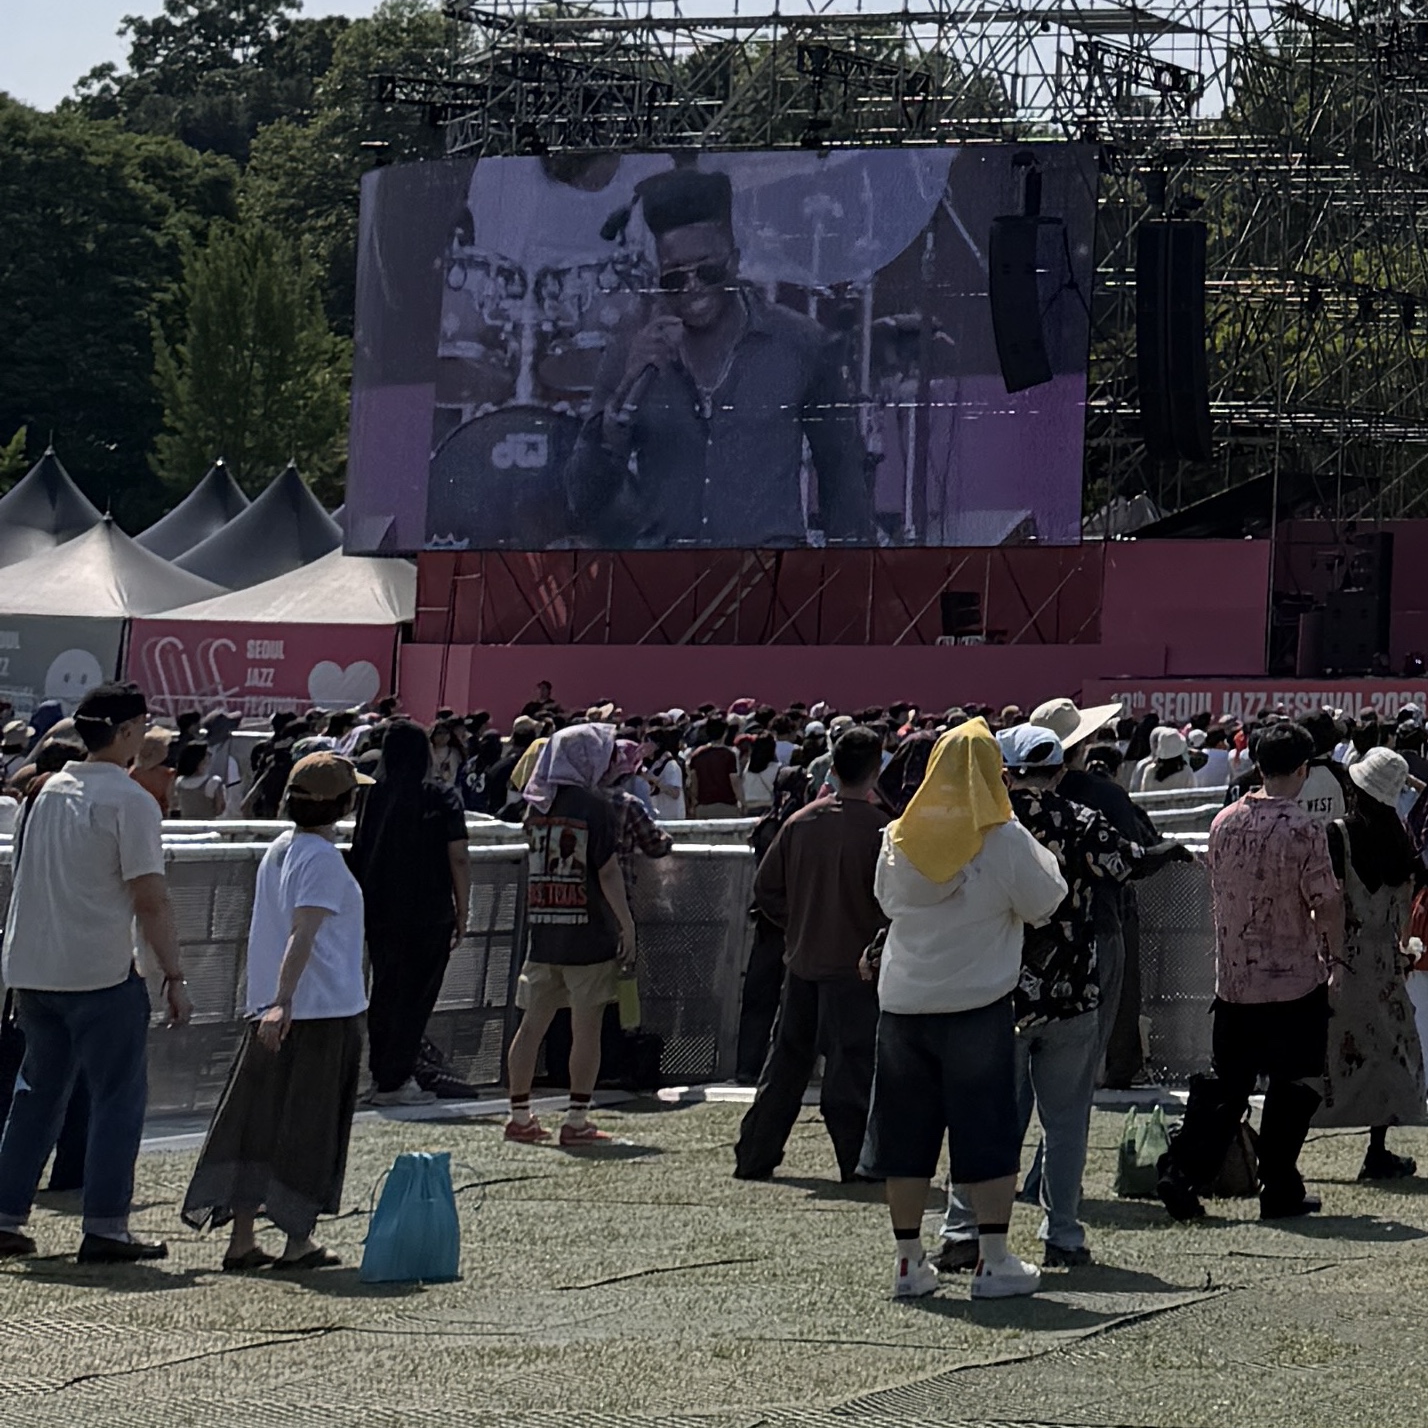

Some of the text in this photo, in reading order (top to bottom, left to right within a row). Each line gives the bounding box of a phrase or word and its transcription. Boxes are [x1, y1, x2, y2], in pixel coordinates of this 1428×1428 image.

[246, 639, 285, 660] SEOUL
[244, 667, 275, 687] JAZZ
[1110, 690, 1146, 720] 8th
[1151, 692, 1214, 723] SEOUL
[1221, 691, 1267, 723] JAZZ
[1307, 797, 1332, 813] WEST
